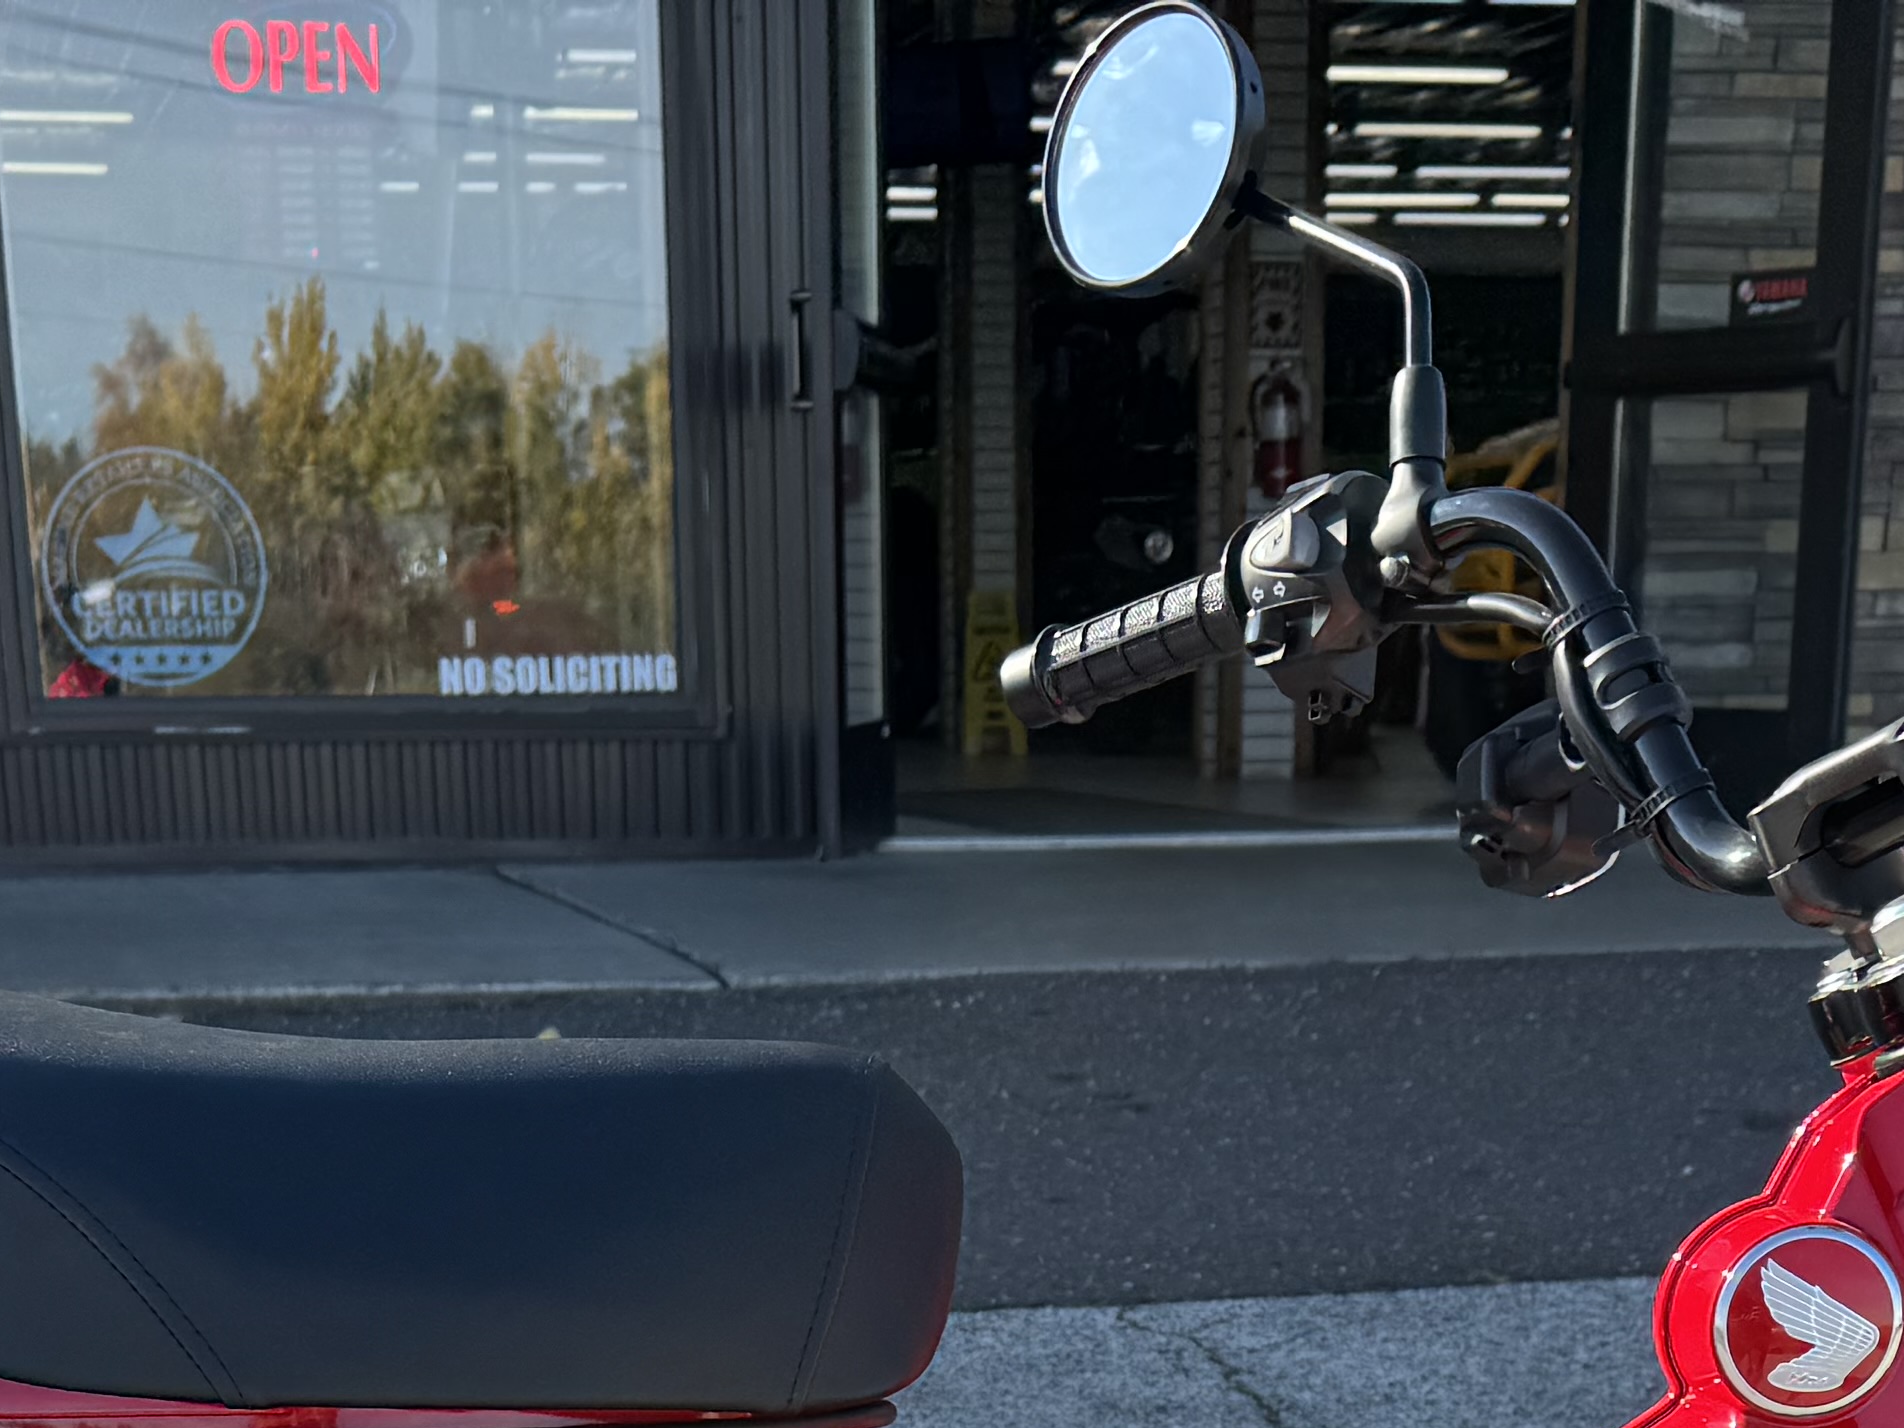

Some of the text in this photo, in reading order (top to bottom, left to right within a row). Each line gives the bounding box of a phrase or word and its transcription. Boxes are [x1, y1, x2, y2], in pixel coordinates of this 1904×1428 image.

[210, 19, 382, 94] OPEN
[70, 589, 246, 619] CERTIFIED
[84, 618, 237, 642] DEALERSHIP
[438, 652, 678, 696] NO SOLICITING
